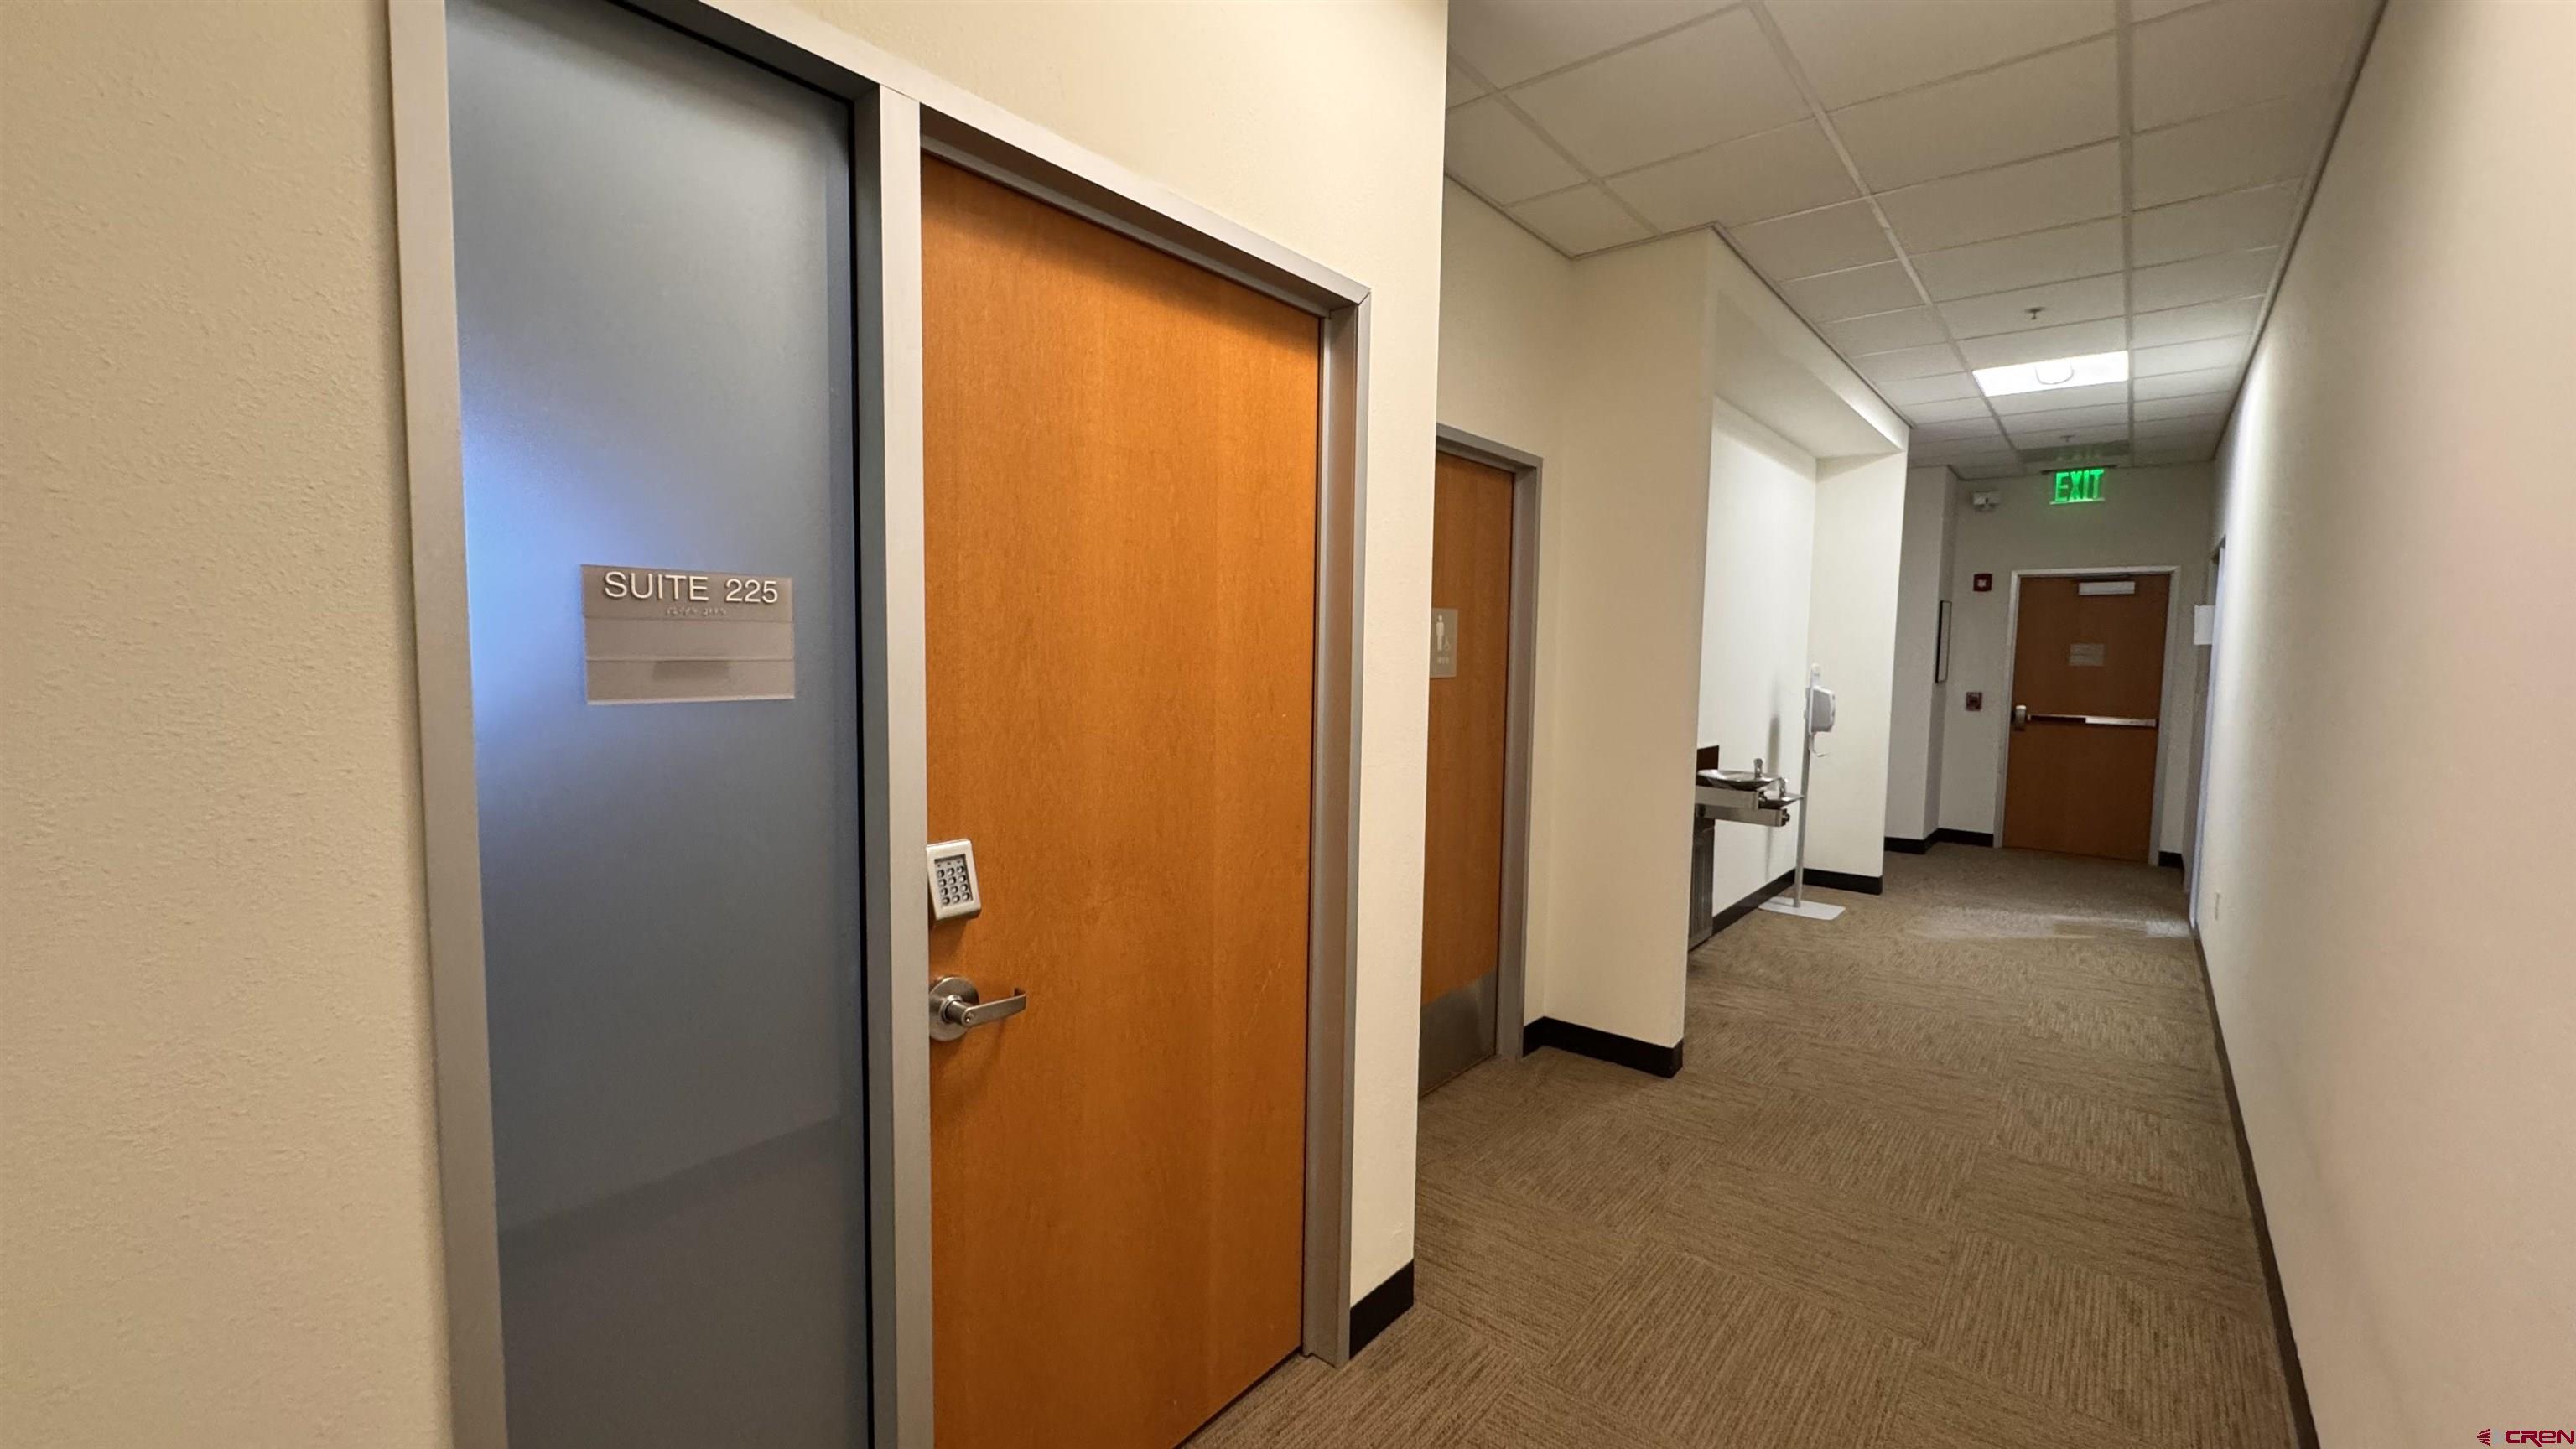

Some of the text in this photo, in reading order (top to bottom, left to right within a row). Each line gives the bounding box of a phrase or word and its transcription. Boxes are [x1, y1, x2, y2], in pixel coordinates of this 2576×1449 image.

[2054, 469, 2105, 502] EXIT
[604, 571, 779, 604] SUITE 225
